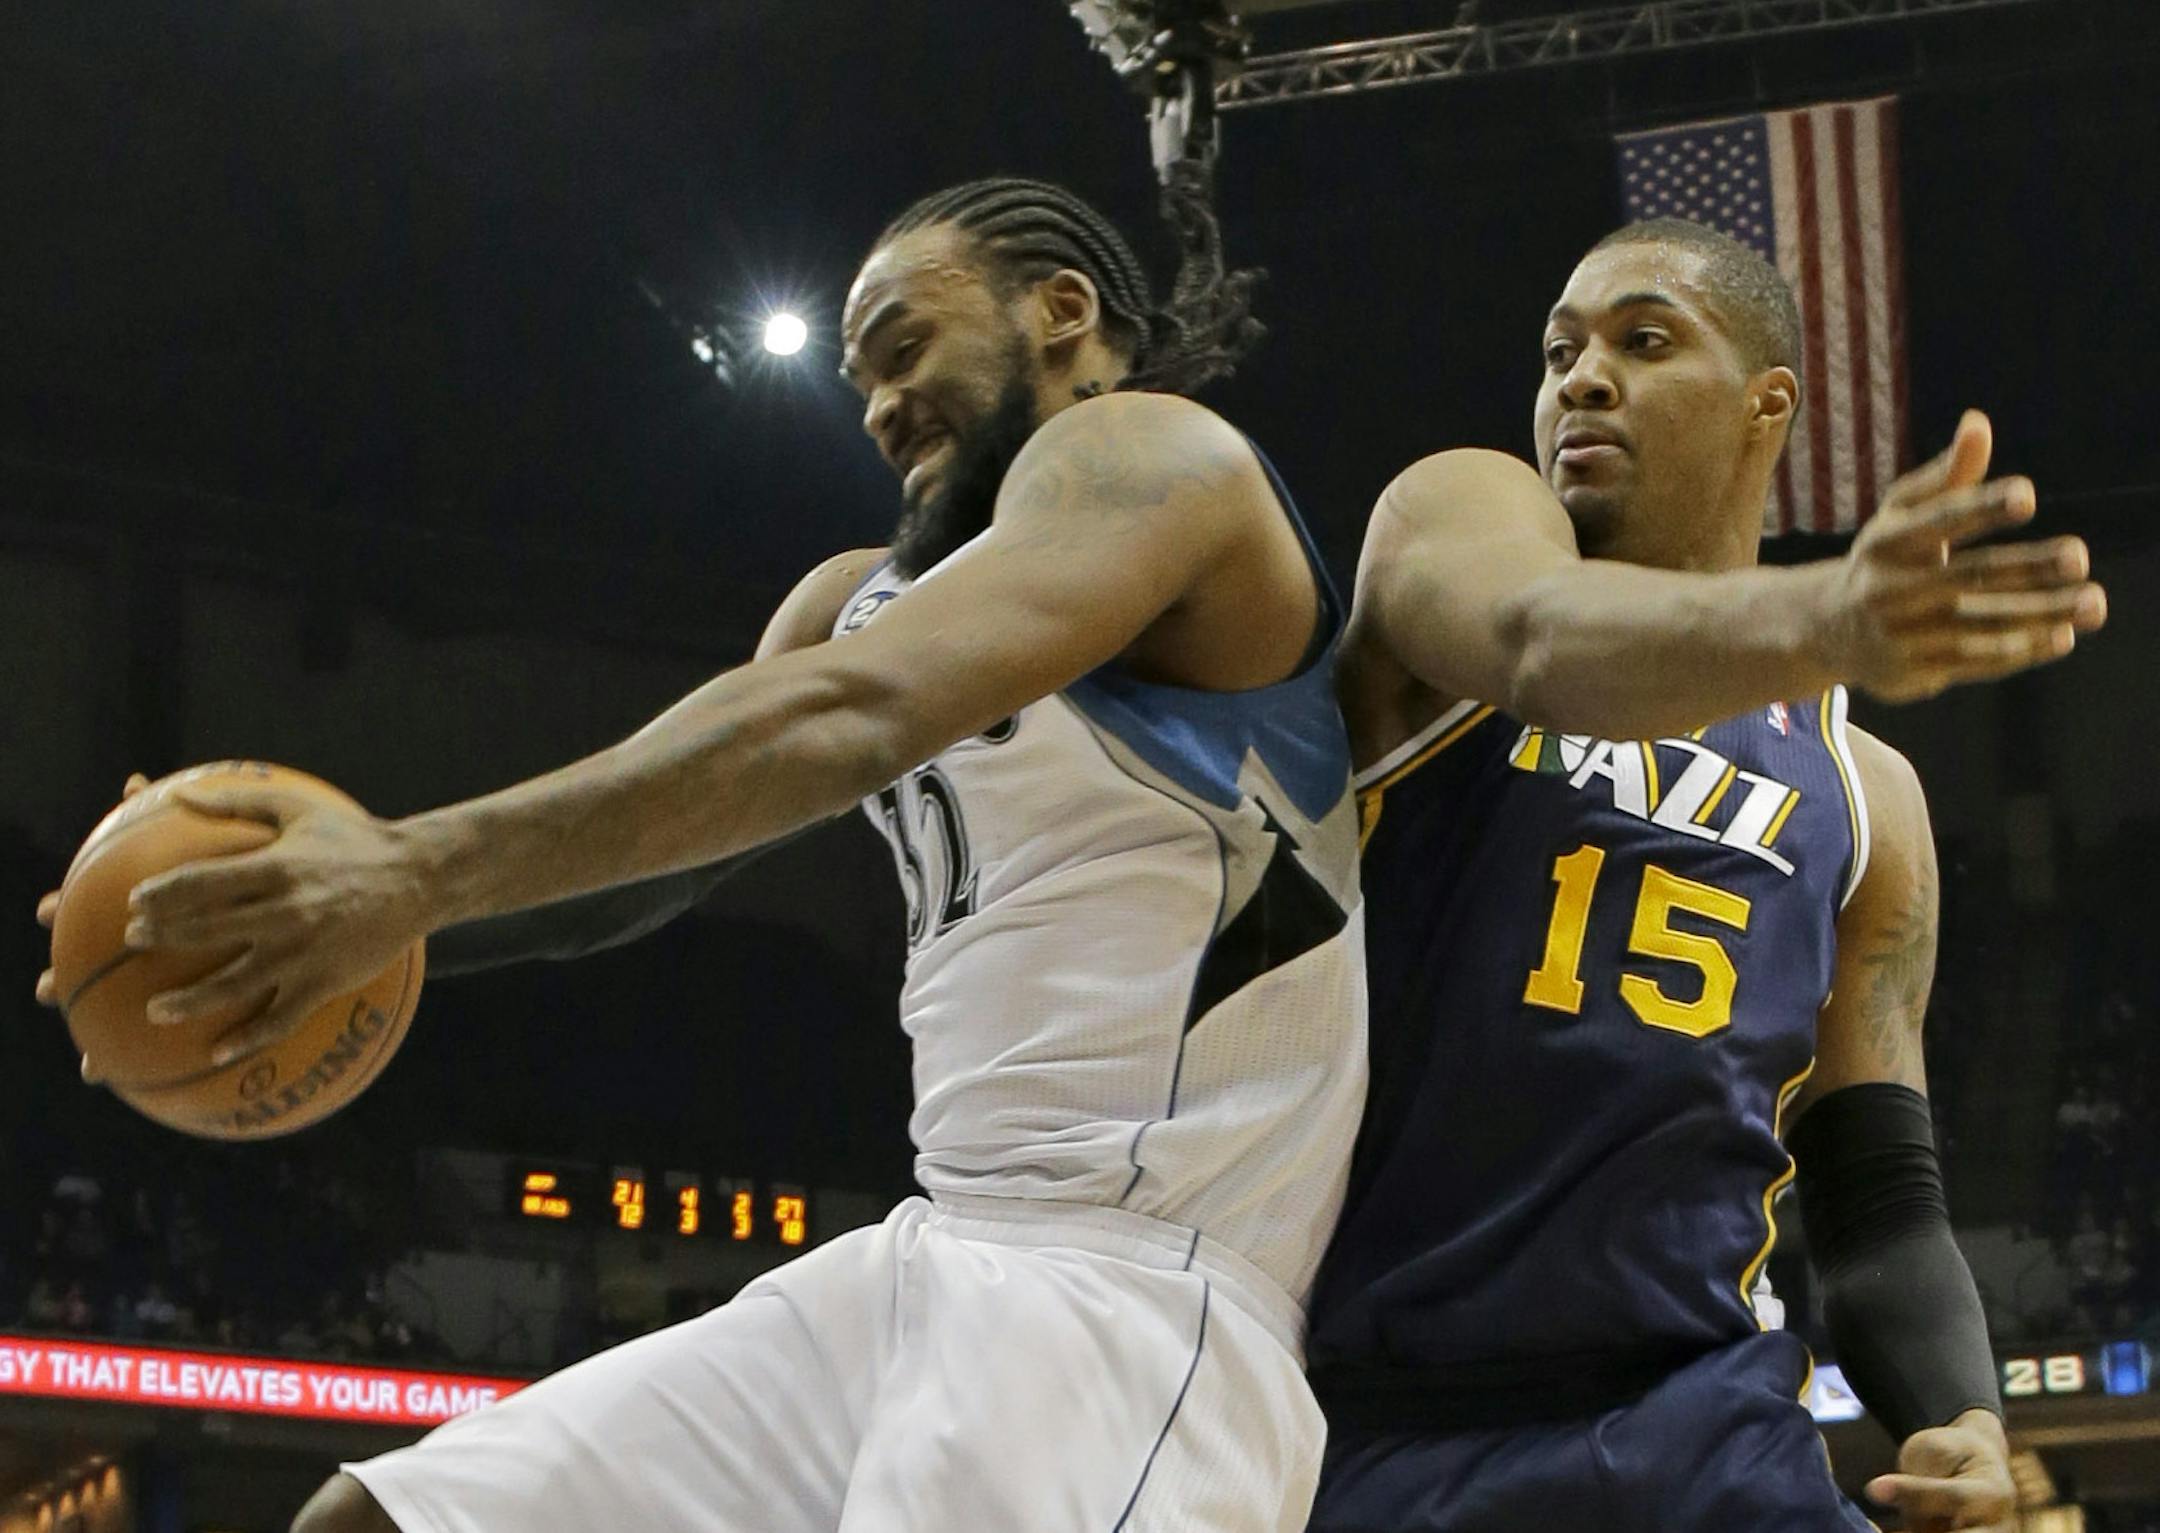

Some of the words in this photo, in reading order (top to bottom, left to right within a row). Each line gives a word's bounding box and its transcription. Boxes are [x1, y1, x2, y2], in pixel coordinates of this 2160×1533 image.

[1522, 843, 1752, 1038] 15
[48, 1352, 132, 1392] THAT
[139, 1360, 301, 1406] ELEVATES
[309, 1374, 398, 1413] YOUR
[2004, 1355, 2085, 1396] 28
